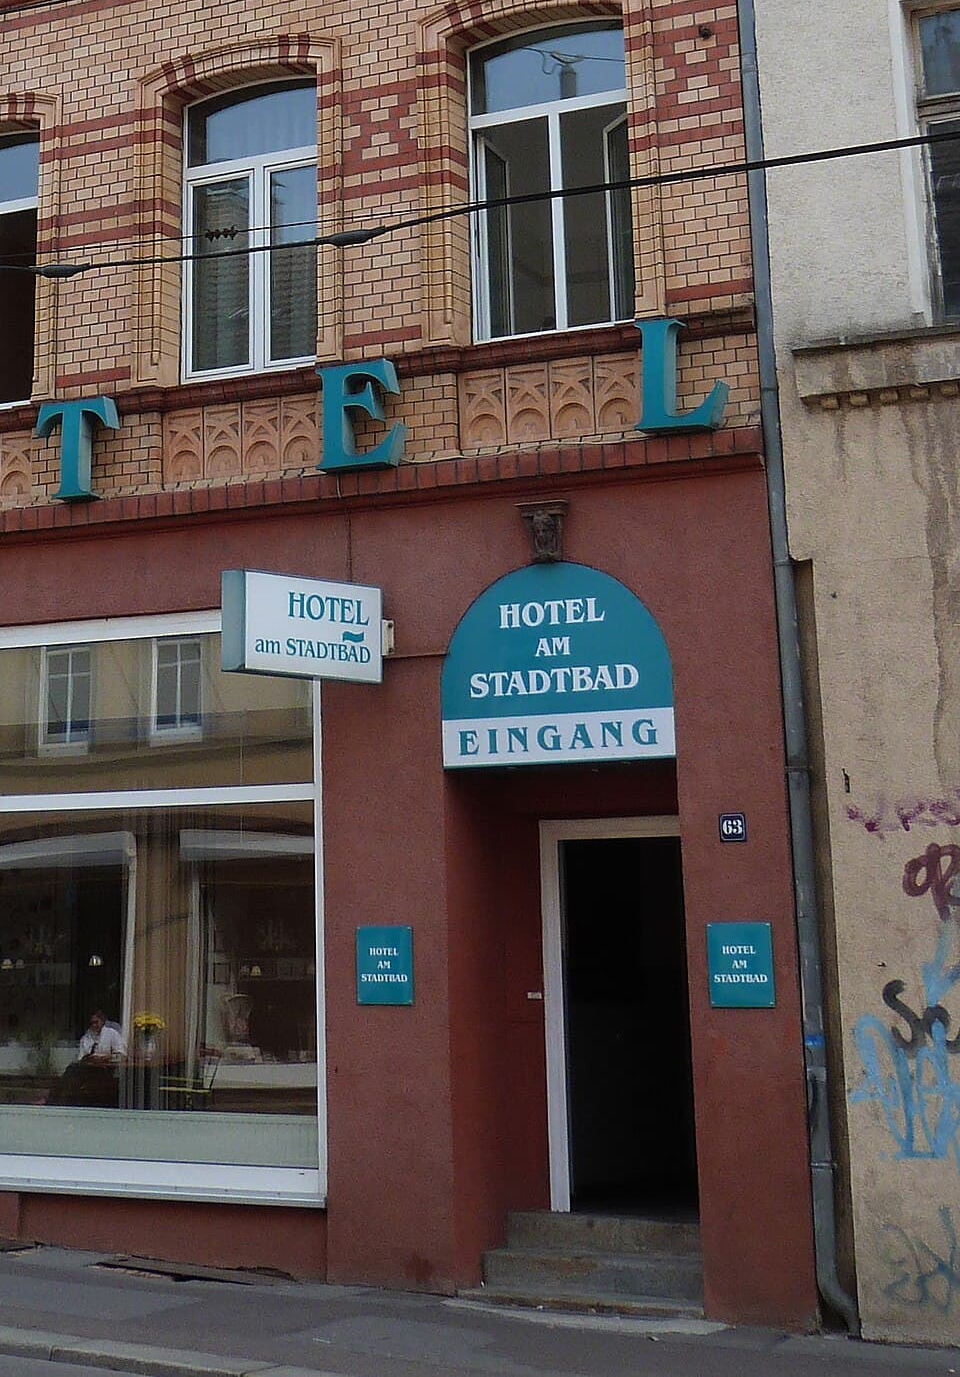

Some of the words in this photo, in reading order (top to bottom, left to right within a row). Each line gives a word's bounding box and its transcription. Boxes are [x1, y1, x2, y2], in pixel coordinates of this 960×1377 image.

[288, 591, 369, 627] HOTEL
[498, 597, 606, 630] HOTEL
[255, 638, 281, 656] am
[286, 638, 371, 664] STADTBAD
[535, 636, 571, 658] AM
[470, 663, 639, 699] STADTBAD
[458, 718, 659, 756] EINGANG
[722, 818, 743, 836] 63
[369, 946, 400, 957] HOTEL
[721, 944, 756, 955] HOTEL
[377, 960, 392, 969] AM
[732, 959, 748, 969] AM
[361, 973, 408, 984] STADTBAD
[714, 973, 768, 984] STADTBAD
